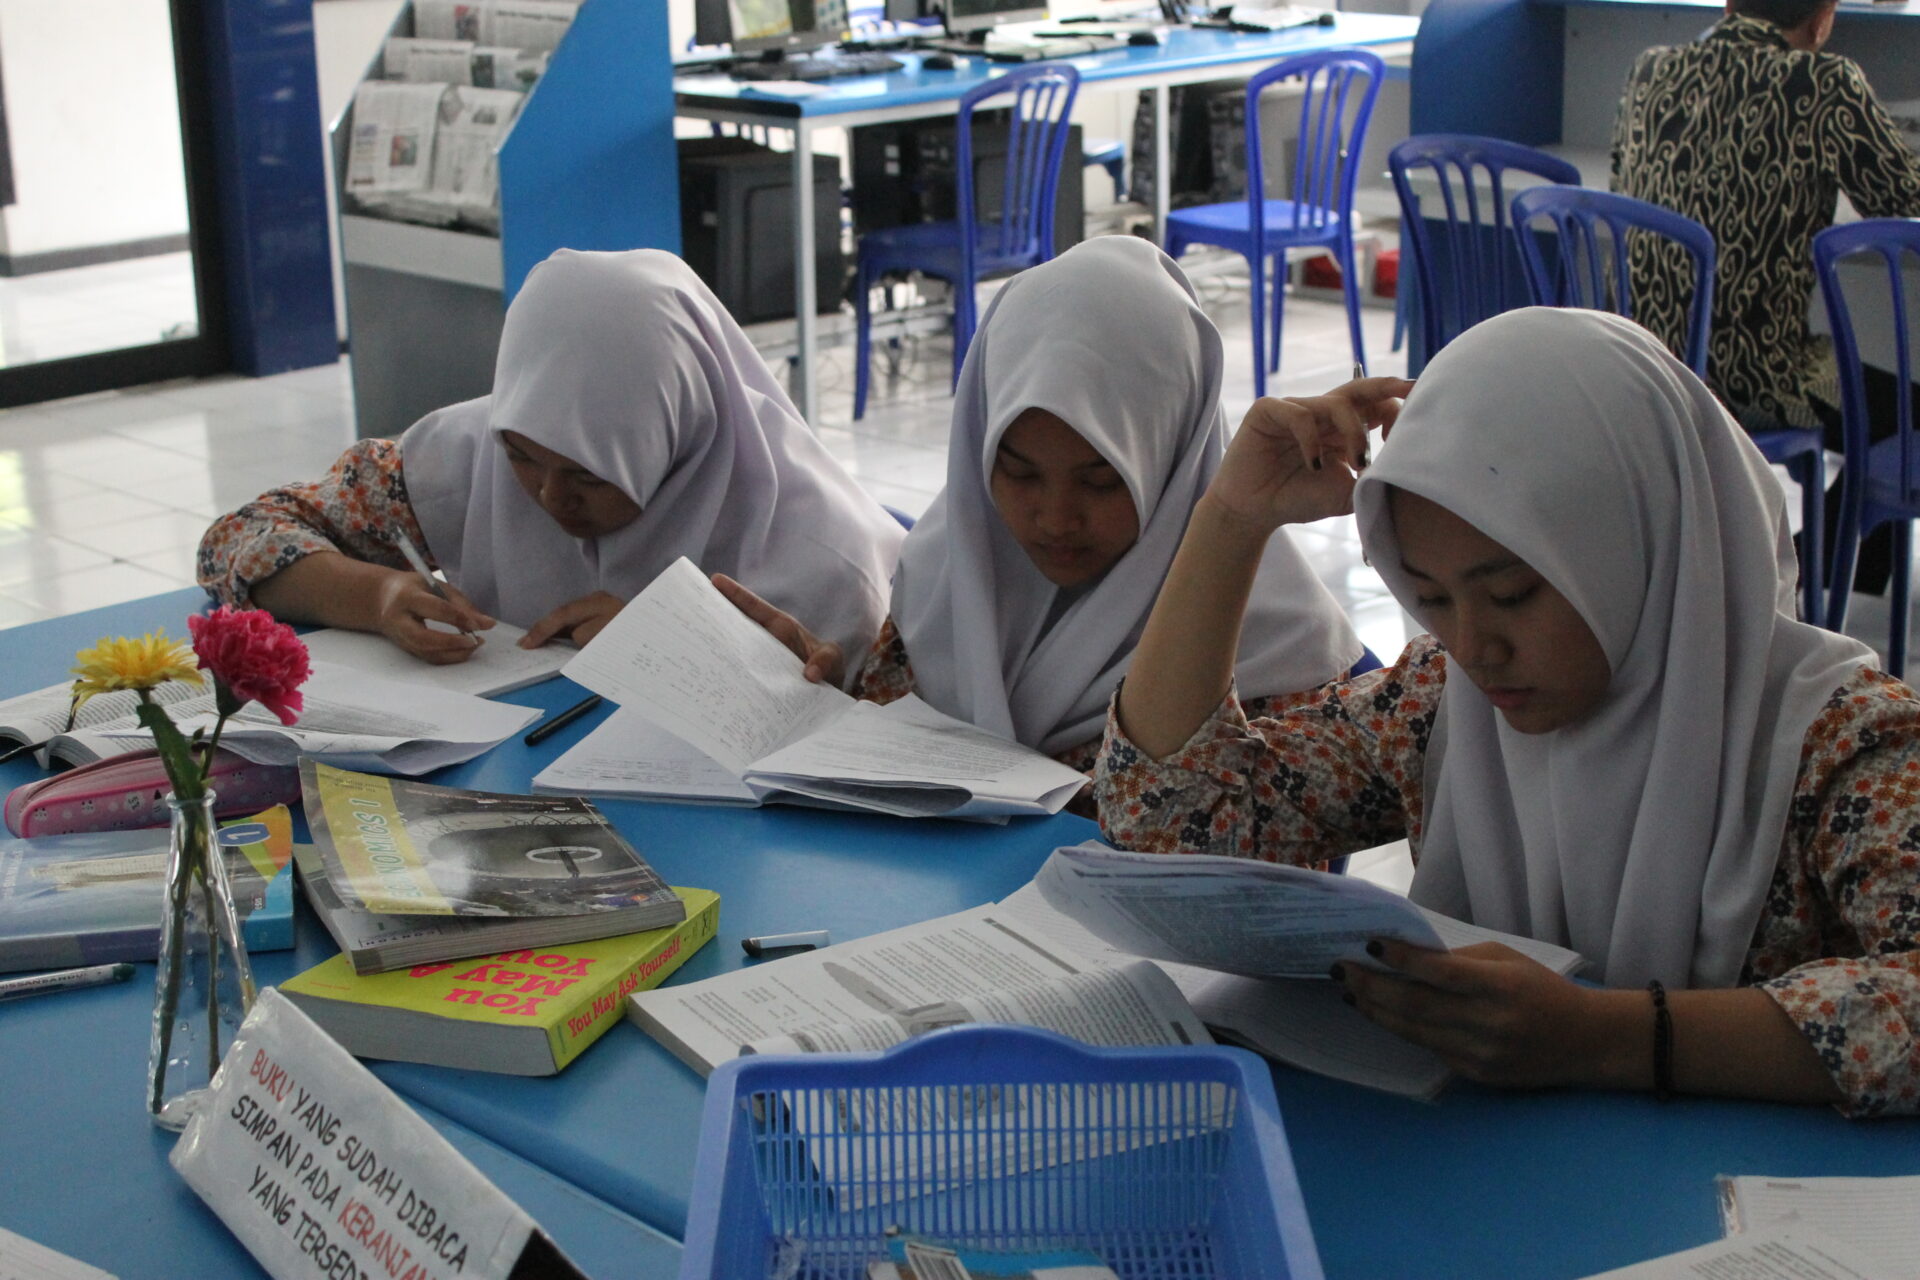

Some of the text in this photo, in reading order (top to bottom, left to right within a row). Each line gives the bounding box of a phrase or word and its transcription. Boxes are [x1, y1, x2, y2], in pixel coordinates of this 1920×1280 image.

[443, 987, 548, 1017] You
[452, 963, 581, 997] May
[567, 934, 681, 1038] You May Ask Yourself
[230, 1093, 301, 1169] SIMPAN
[294, 1152, 342, 1213] PADA
[249, 1047, 468, 1275] BUKU YANG SUDAH DIBACA
[247, 1164, 297, 1227] YANG
